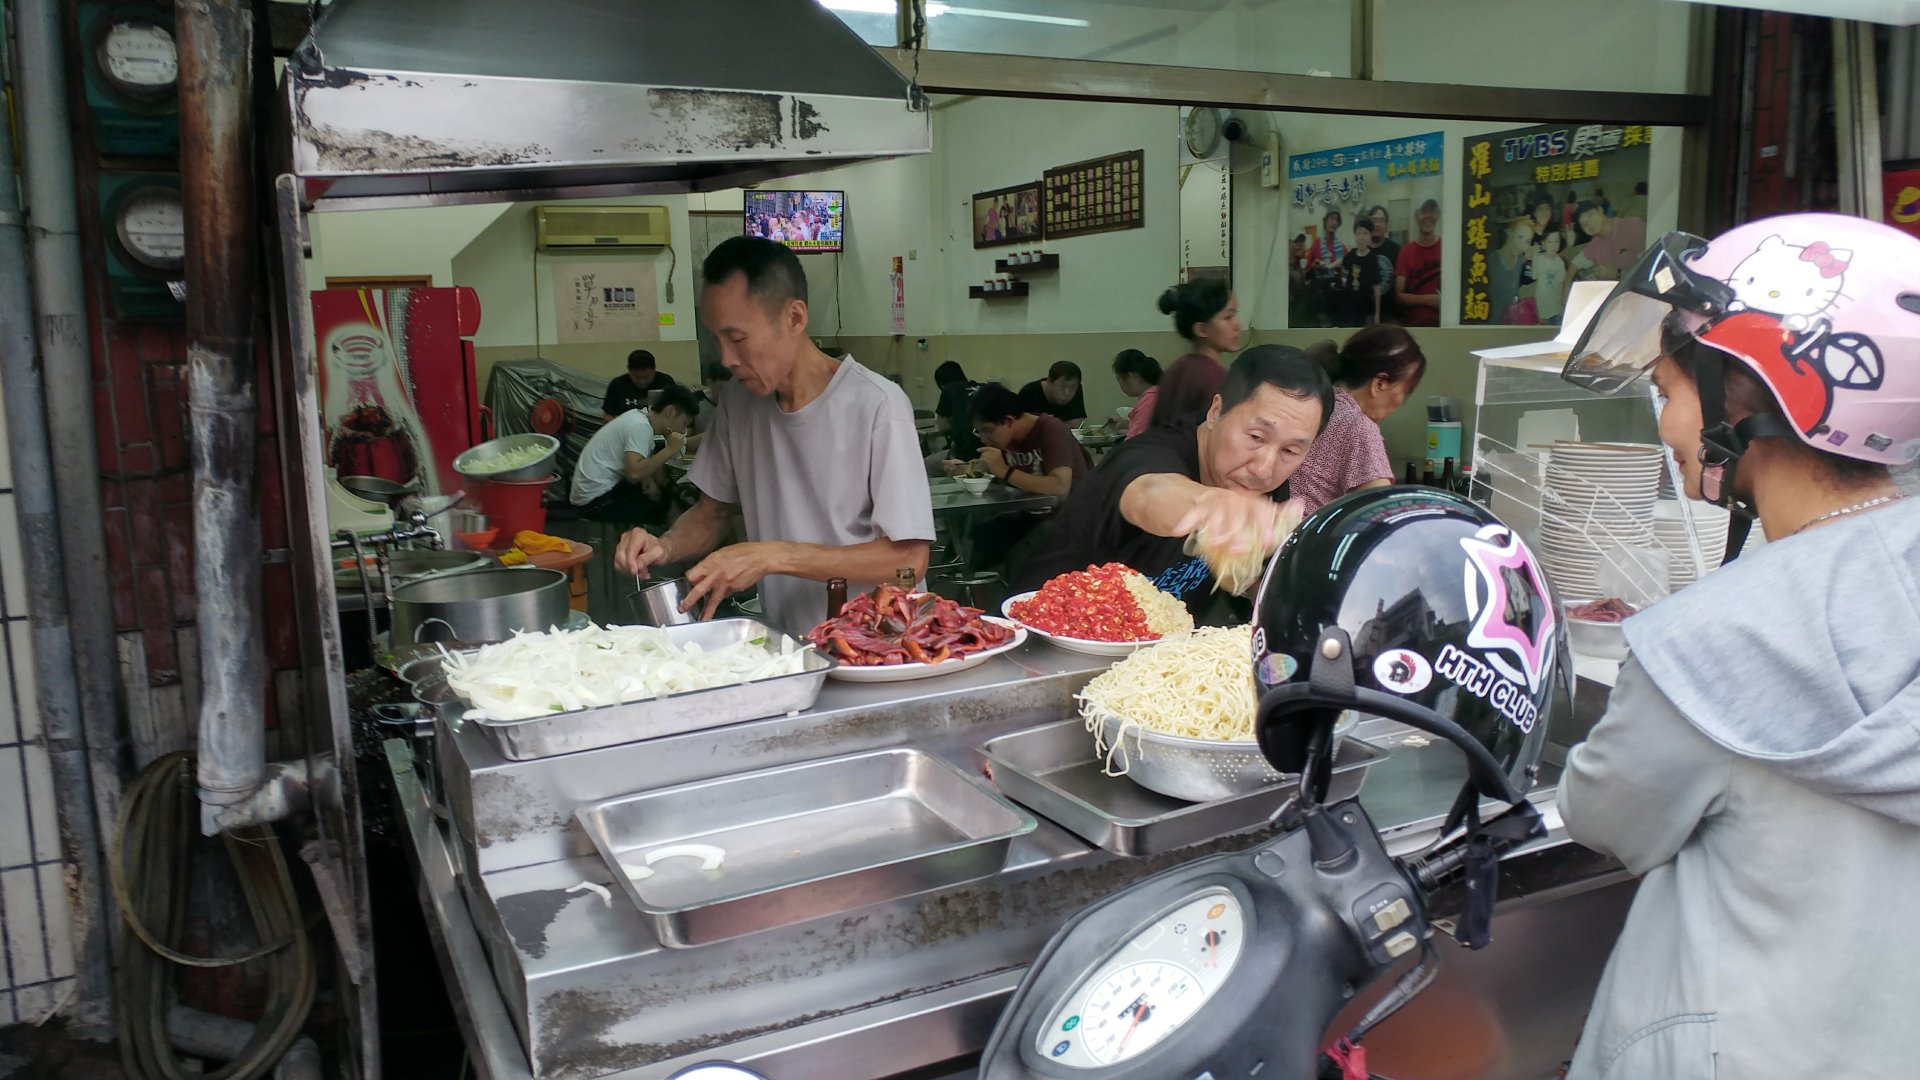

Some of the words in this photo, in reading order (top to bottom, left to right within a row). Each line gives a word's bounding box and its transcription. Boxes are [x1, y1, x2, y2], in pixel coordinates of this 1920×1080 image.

[1501, 130, 1570, 162] TVBS
[1536, 159, 1600, 184] 特別推薦
[1435, 644, 1495, 697] HTH
[1490, 679, 1537, 733] CLUB
